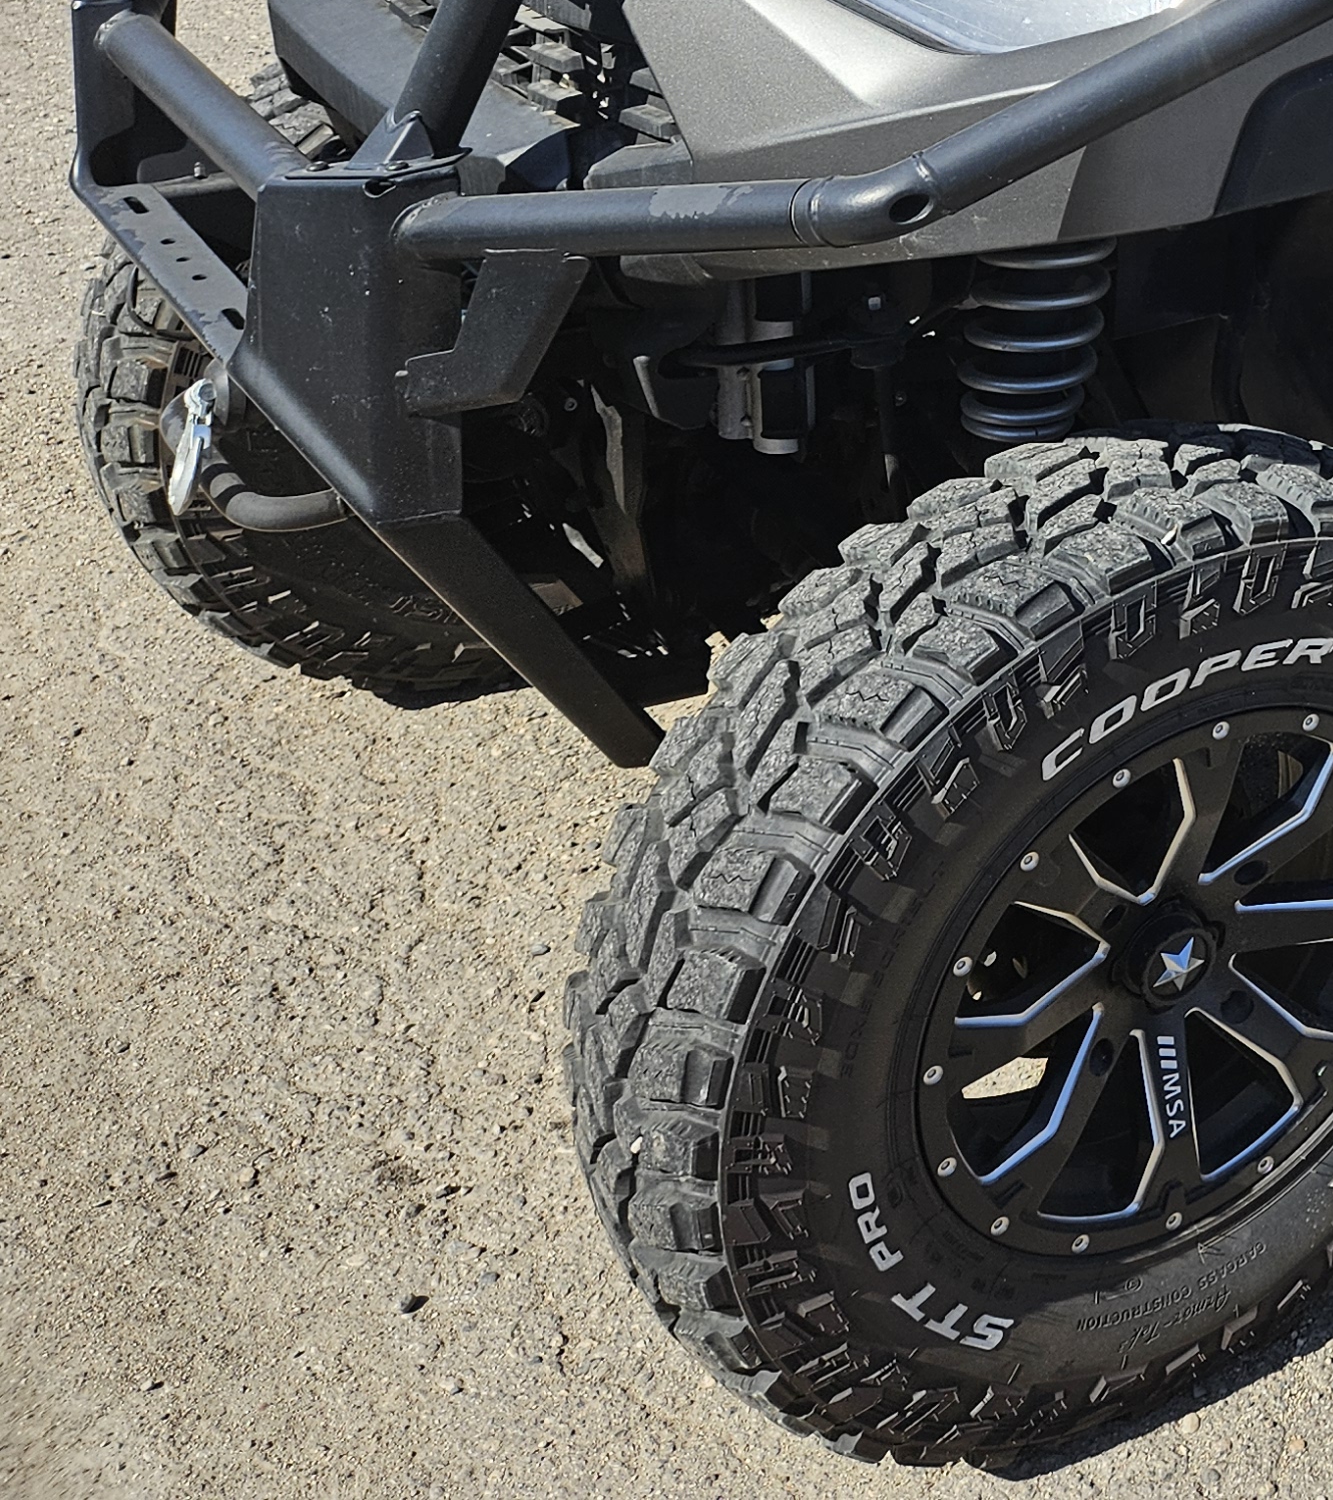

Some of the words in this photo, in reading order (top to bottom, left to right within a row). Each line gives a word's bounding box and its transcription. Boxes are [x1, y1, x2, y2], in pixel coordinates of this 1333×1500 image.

[1162, 1072, 1188, 1139] MSA
[848, 1171, 904, 1272] PRO
[1197, 1241, 1268, 1291] CARCASS
[891, 1282, 1015, 1351] STT
[1077, 1285, 1193, 1332] CONSTRUCTION
